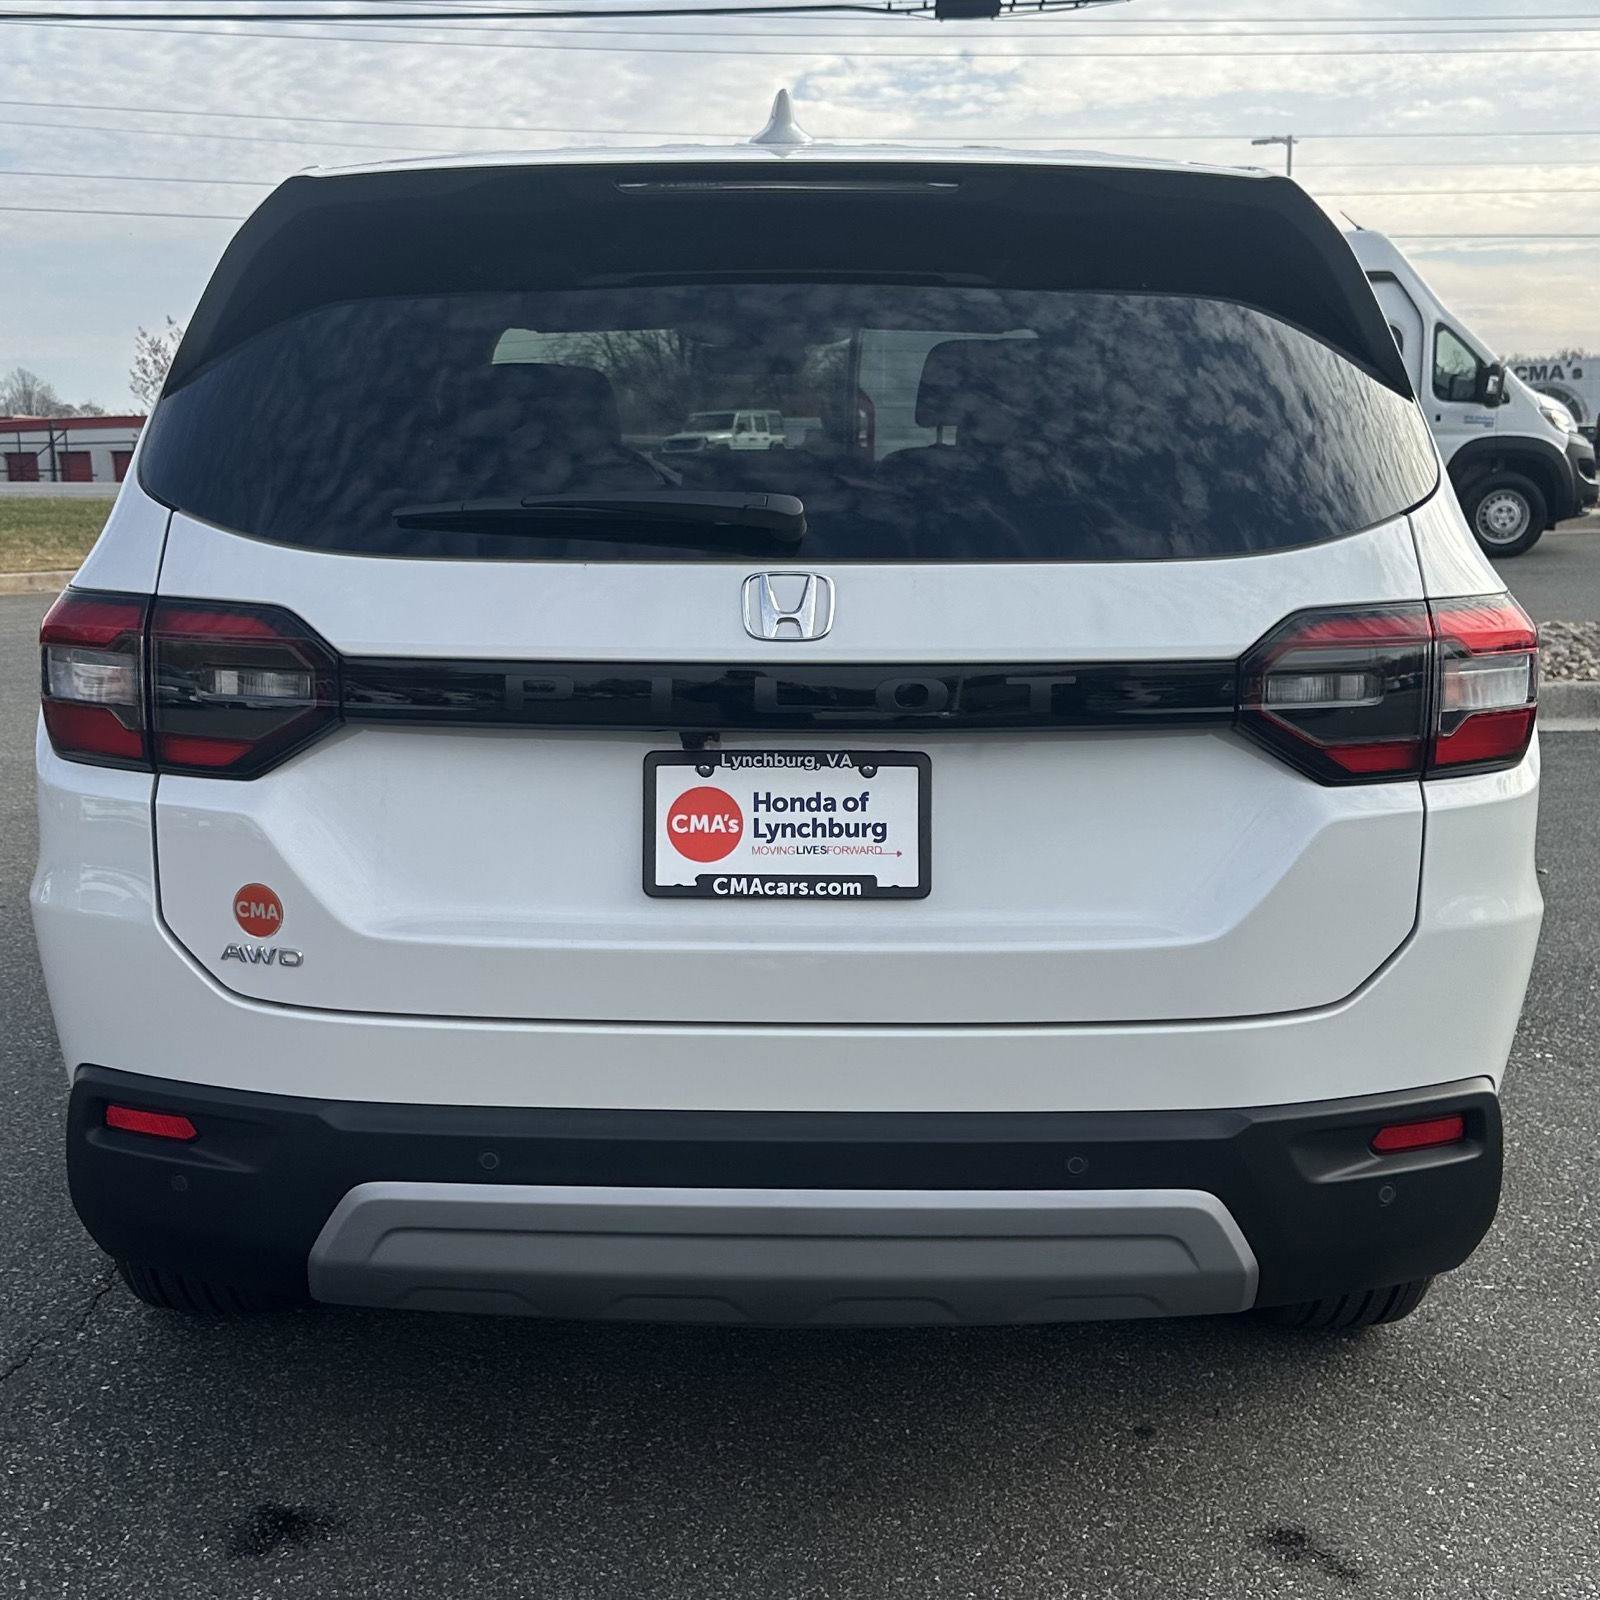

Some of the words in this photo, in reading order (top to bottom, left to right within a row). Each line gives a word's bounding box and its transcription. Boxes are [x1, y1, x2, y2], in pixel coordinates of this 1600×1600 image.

[505, 675, 1077, 714] PILOT
[720, 753, 821, 769] Lynchburg,
[826, 754, 853, 767] VA
[753, 791, 837, 813] Honda
[842, 791, 870, 813] of
[671, 814, 740, 834] CMA's
[753, 817, 888, 844] Lynchburg
[712, 877, 862, 896] CMAcars.com
[236, 900, 280, 921] CMA
[221, 943, 304, 968] AWD
